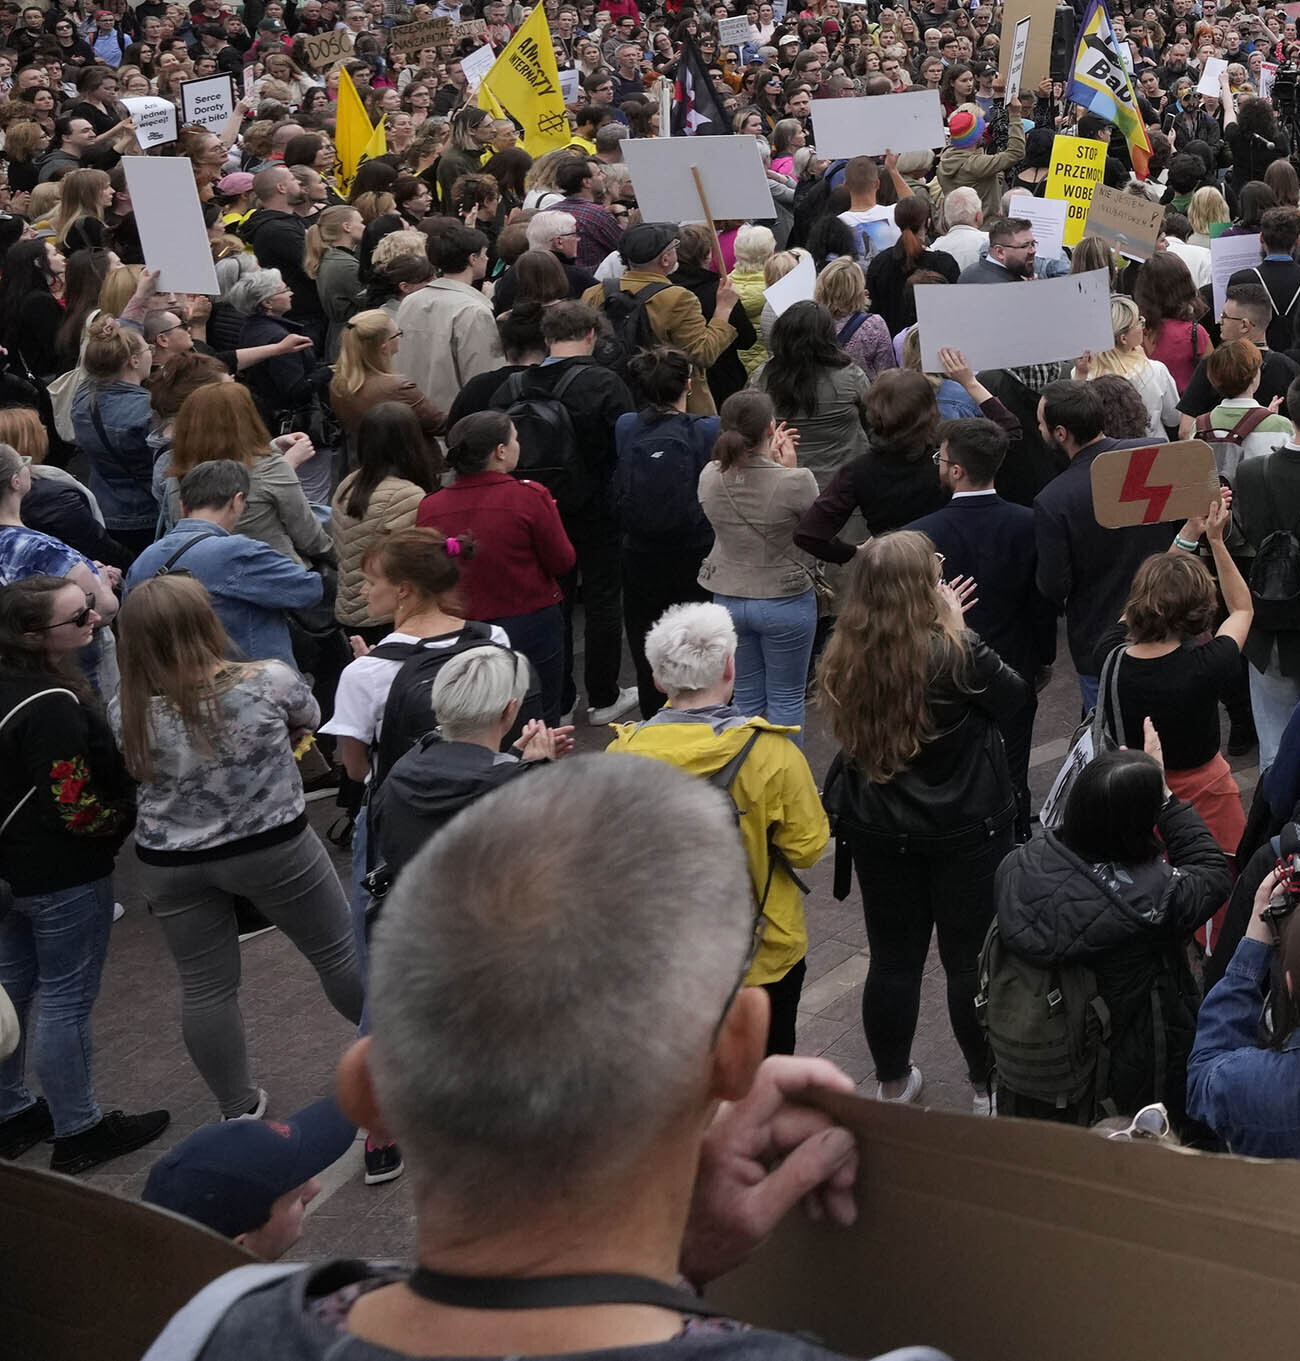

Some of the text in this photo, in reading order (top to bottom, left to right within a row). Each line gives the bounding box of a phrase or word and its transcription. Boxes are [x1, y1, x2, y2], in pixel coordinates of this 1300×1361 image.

[194, 92, 222, 104] Serce
[194, 102, 224, 115] Doroty
[1076, 144, 1098, 160] STOP
[1064, 184, 1093, 200] WOBE
